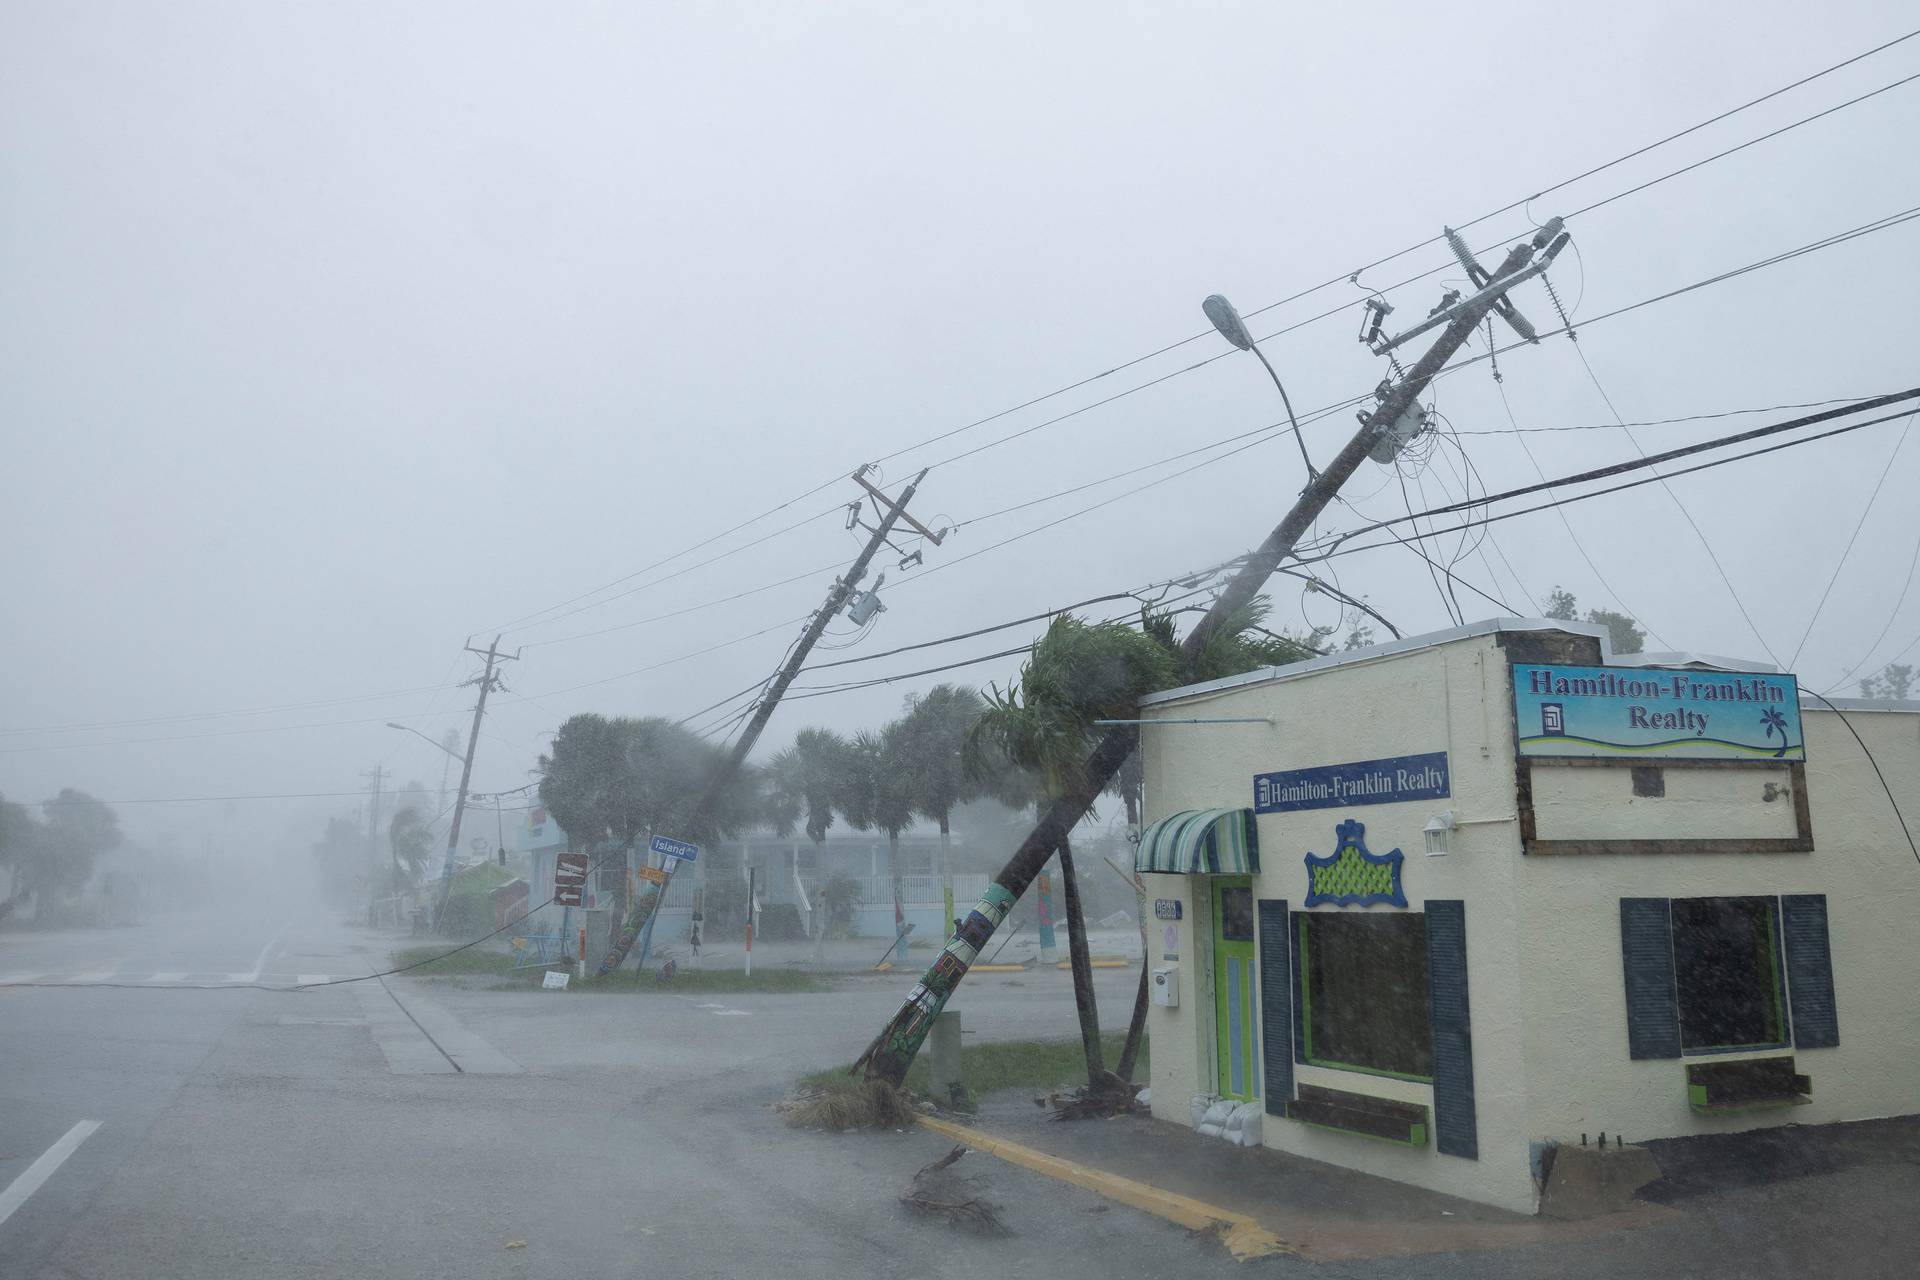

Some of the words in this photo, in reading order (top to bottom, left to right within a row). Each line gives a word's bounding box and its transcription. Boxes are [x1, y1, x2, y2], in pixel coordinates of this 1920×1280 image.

[1529, 669, 1785, 703] Hamilton-Franklin
[1627, 704, 1710, 737] Realty
[1272, 773, 1392, 803] Hamilton-Franklin
[1396, 766, 1445, 794] Realty
[655, 839, 686, 856] Island
